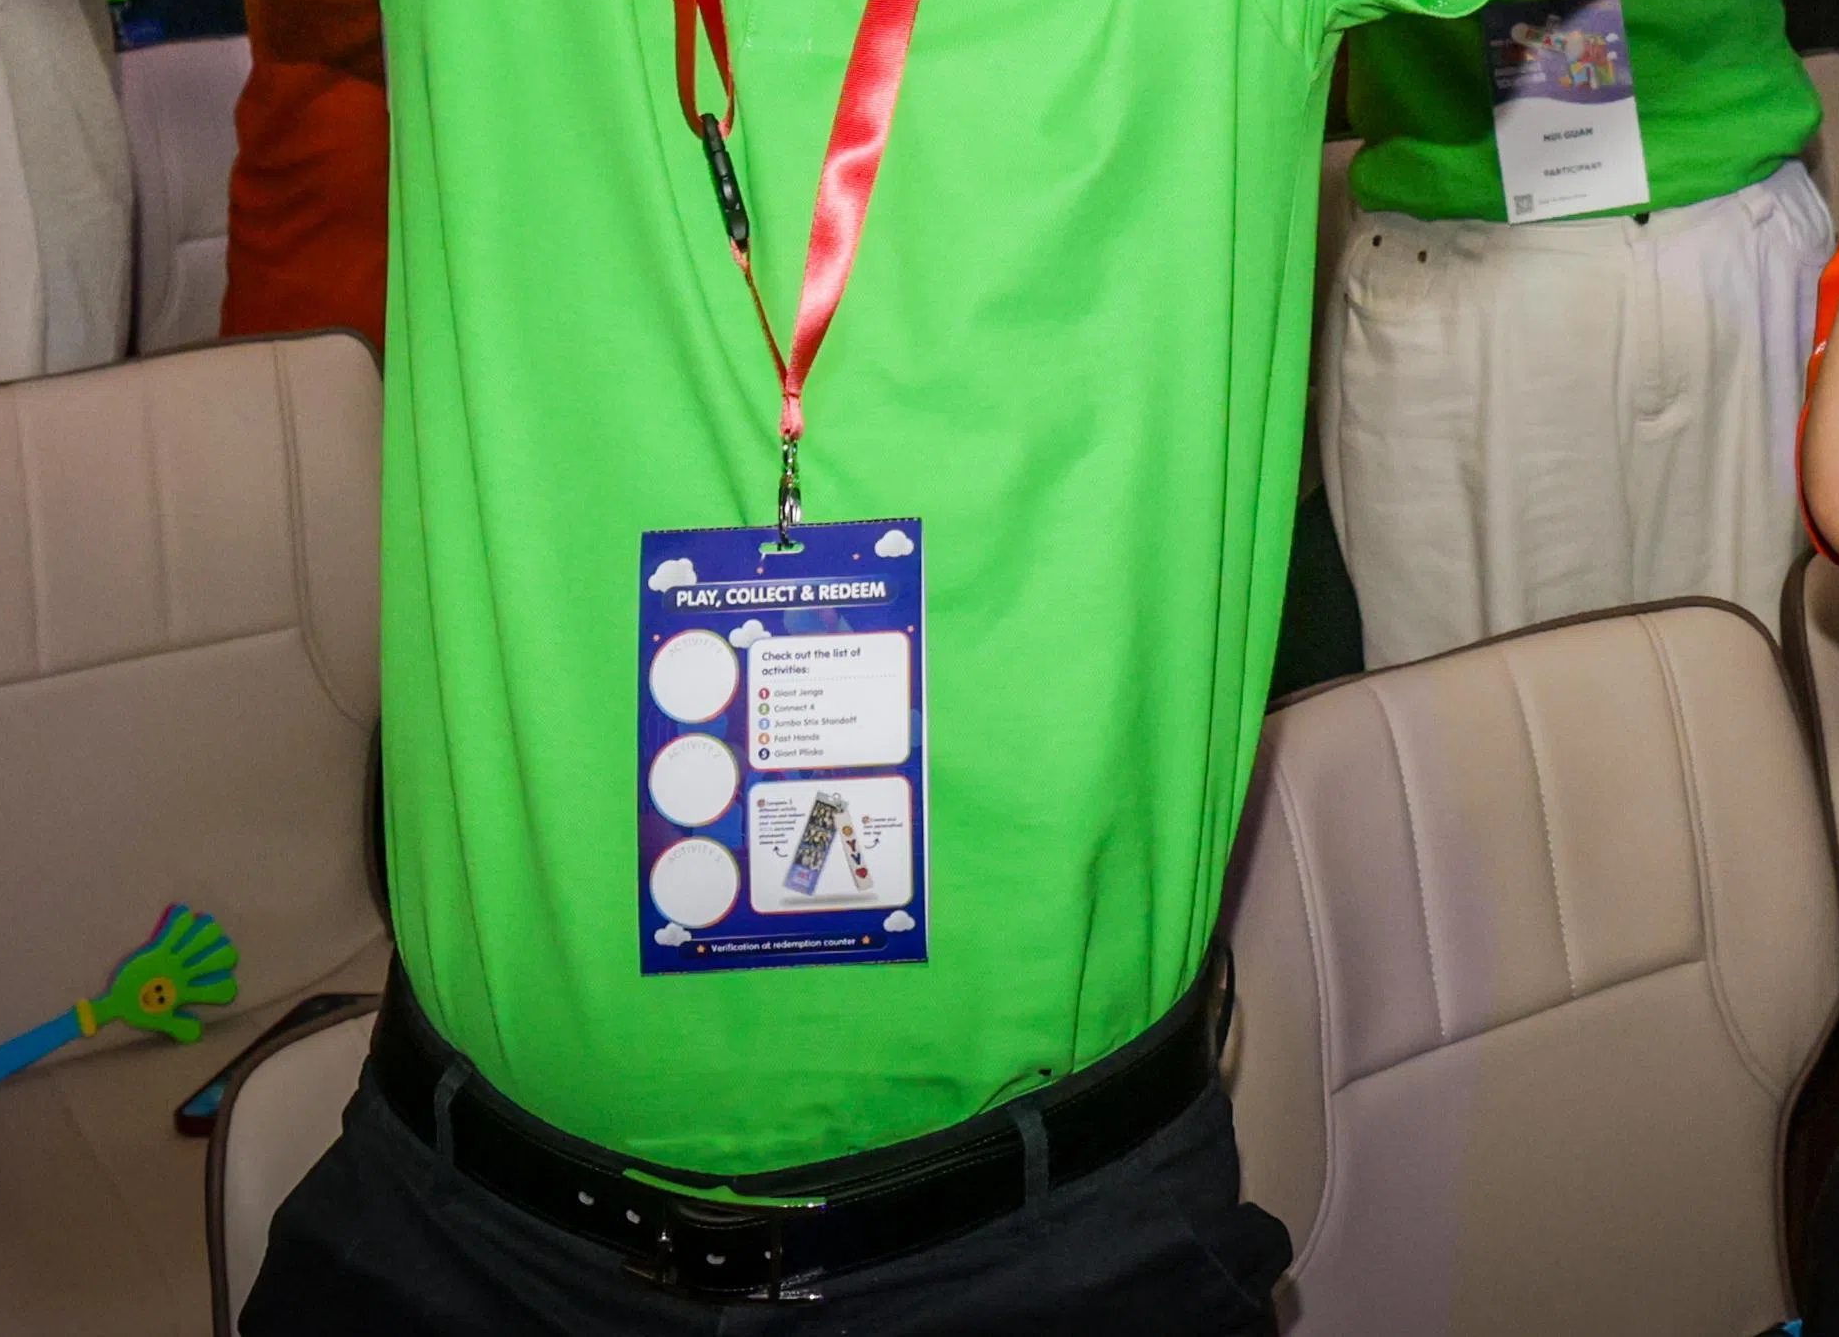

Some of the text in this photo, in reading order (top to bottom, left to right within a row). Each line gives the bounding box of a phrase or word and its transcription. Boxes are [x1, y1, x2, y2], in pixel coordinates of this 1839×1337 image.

[676, 581, 886, 608] PLAY, COLLECT & REDEEM
[762, 647, 861, 661] Check out the list of
[762, 665, 810, 676] activities:
[711, 937, 856, 953] Verification at redemption counter
